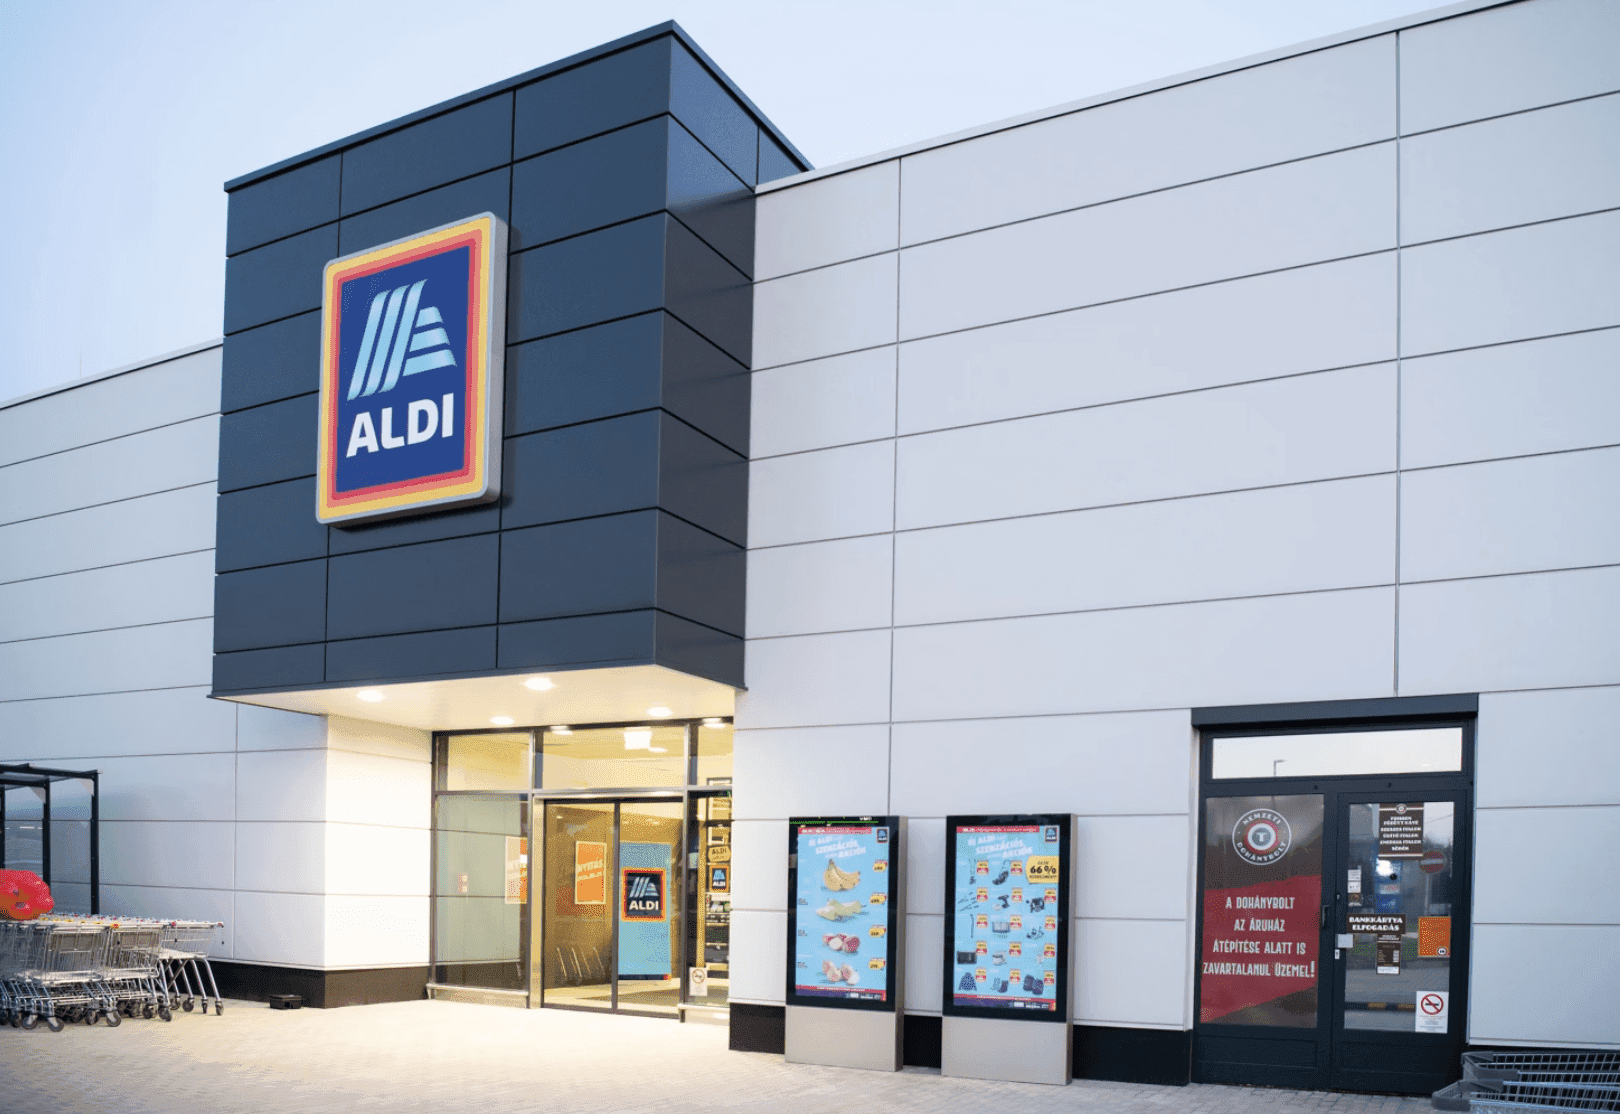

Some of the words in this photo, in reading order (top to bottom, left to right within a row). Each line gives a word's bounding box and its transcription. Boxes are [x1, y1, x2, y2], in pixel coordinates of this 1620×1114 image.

[346, 392, 454, 458] ALDI
[1242, 812, 1281, 825] NEMZETI
[1237, 841, 1286, 861] DOHÁNYBOLT
[628, 900, 660, 911] ALDI
[1225, 896, 1232, 909] A
[1236, 895, 1295, 909] DOHÁNYBOLT
[1233, 919, 1246, 932] AZ
[1249, 917, 1285, 932] ÁRUHÁZ
[1348, 915, 1403, 924] BANKKÁRTYA
[1352, 923, 1400, 932] ELFOGADÁS
[1212, 939, 1260, 953] ÁTÉPÍTÉSE
[1263, 941, 1293, 955] ALATT
[1296, 942, 1306, 955] IS
[1203, 962, 1271, 977] ZAVARTALANUL
[1274, 960, 1316, 978] ÜZEMEL!
